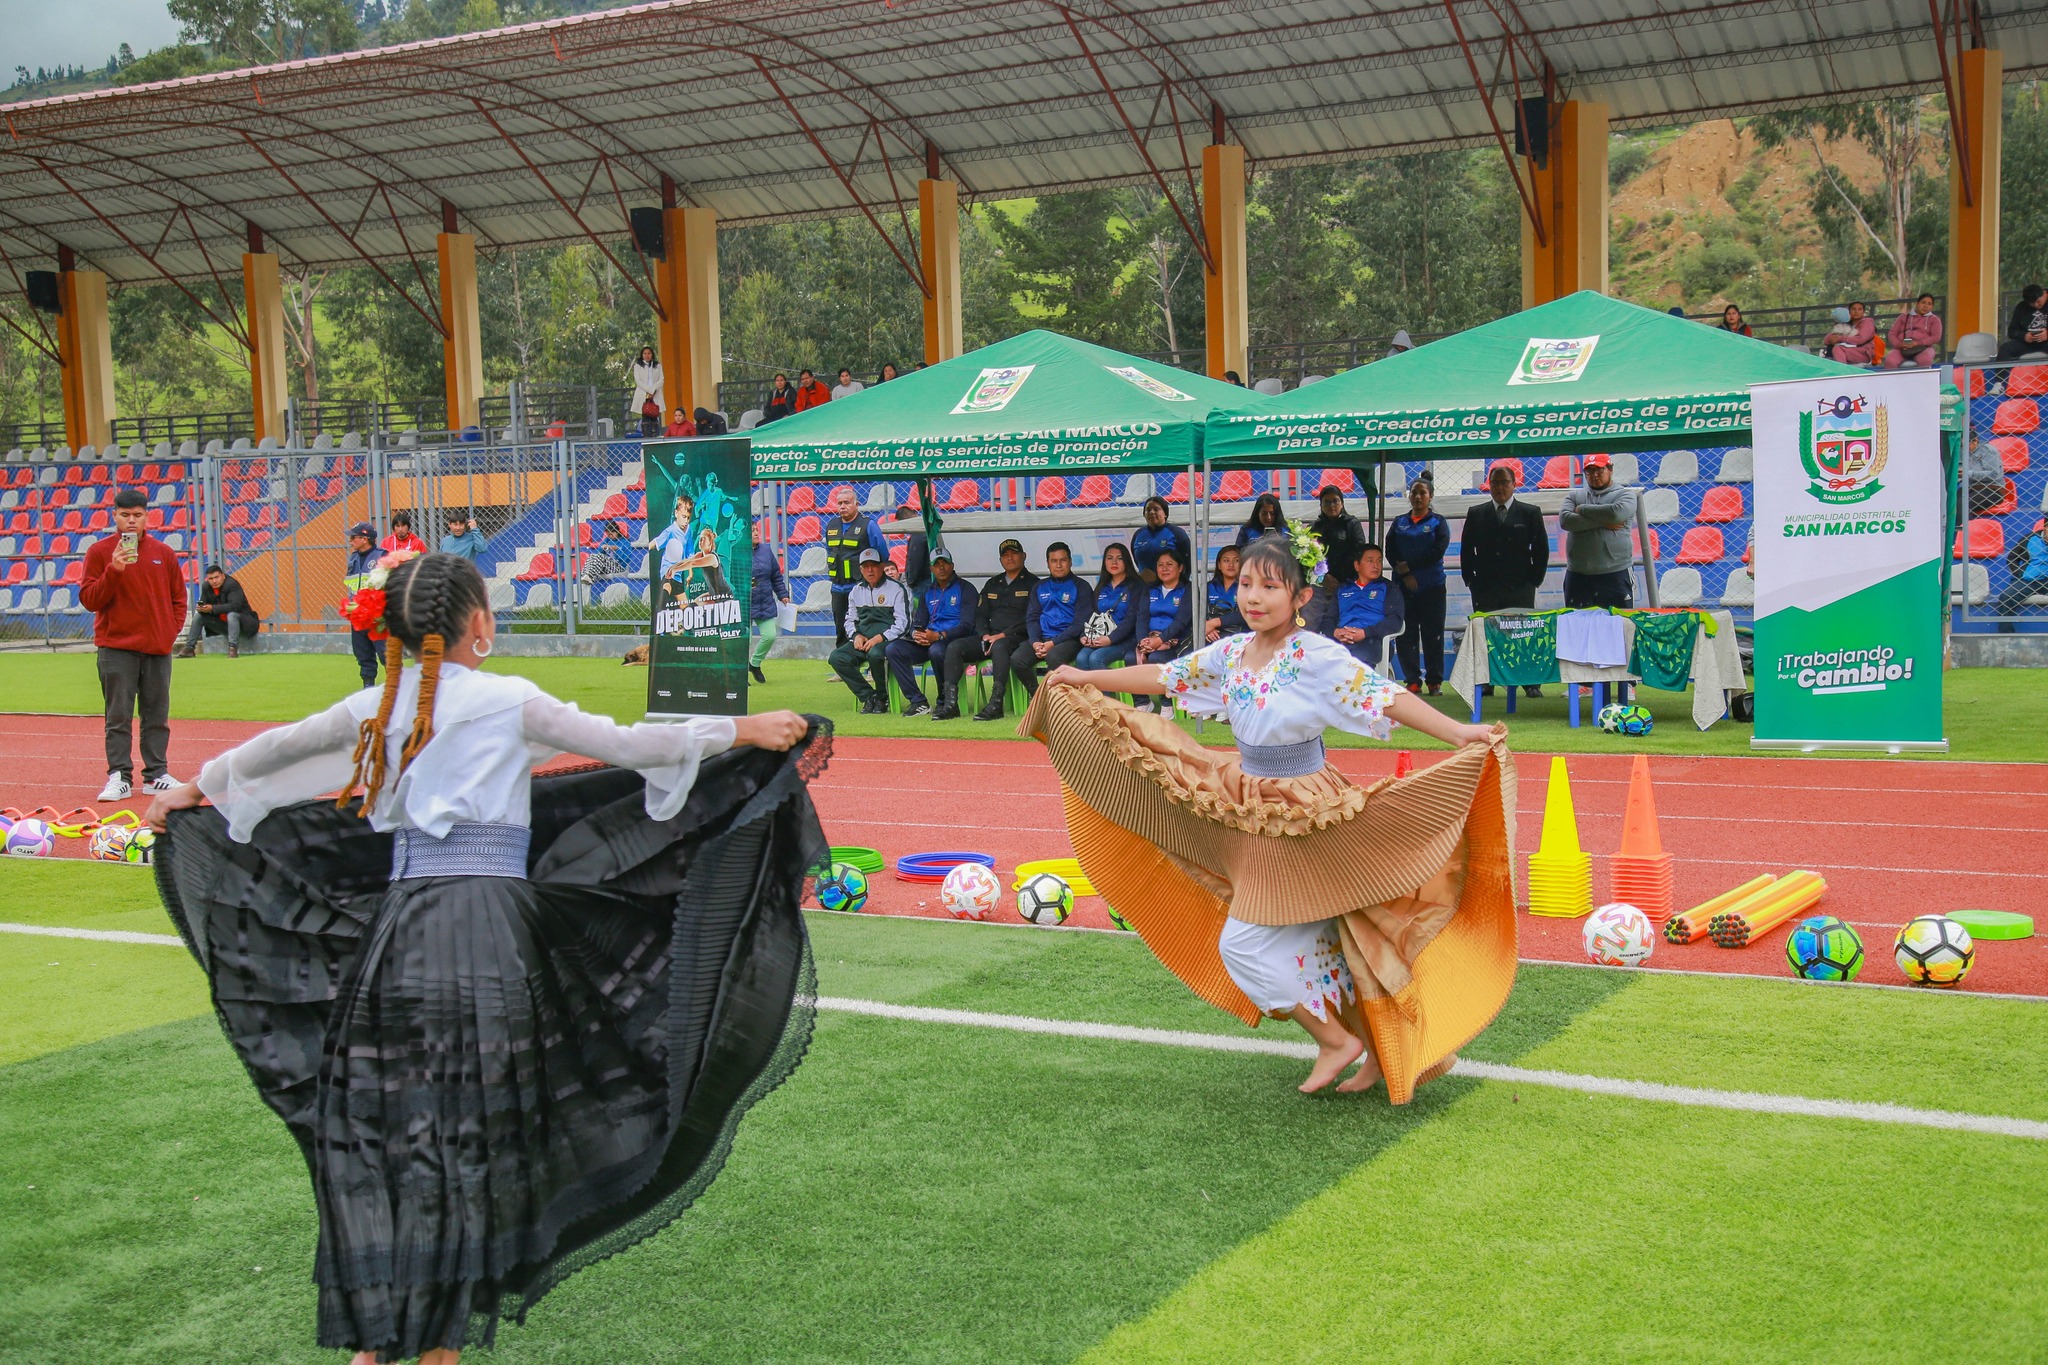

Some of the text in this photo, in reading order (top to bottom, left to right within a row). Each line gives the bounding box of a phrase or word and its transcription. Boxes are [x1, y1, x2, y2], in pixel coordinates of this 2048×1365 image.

[1253, 422, 1347, 437] Proyecto:
[1462, 413, 1488, 426] de
[1495, 412, 1527, 425] los
[1533, 405, 1633, 423] servicios
[1641, 402, 1668, 416] de
[1675, 401, 1752, 418] promo
[1065, 423, 1163, 438] MARCOS
[1278, 413, 1752, 450] para los productores y comerciantes locale
[750, 450, 808, 463] oyecto:
[894, 446, 914, 457] de
[919, 446, 943, 457] los
[948, 442, 1022, 456] servicios
[1027, 442, 1049, 453] de
[1053, 438, 1148, 454] promoción
[756, 464, 789, 475] para
[794, 461, 816, 472] los
[821, 460, 917, 474] productores
[921, 461, 932, 472] y
[936, 455, 1049, 470] comerciantes
[1823, 492, 1865, 501] SAN MARCOS
[1785, 510, 1911, 523] MUNICIPALIDAD DISTRITAL DE
[1783, 519, 1906, 537] SAN MARCOS
[690, 582, 706, 593] 2024
[666, 598, 694, 607] ACADEMIA
[656, 600, 742, 634] DEPORTIVA
[1500, 620, 1545, 629] MANUEL UGARTE
[1511, 631, 1534, 639] Alcalde
[1777, 645, 1894, 672] ¡Trabajando
[1797, 658, 1913, 688] Cambio!
